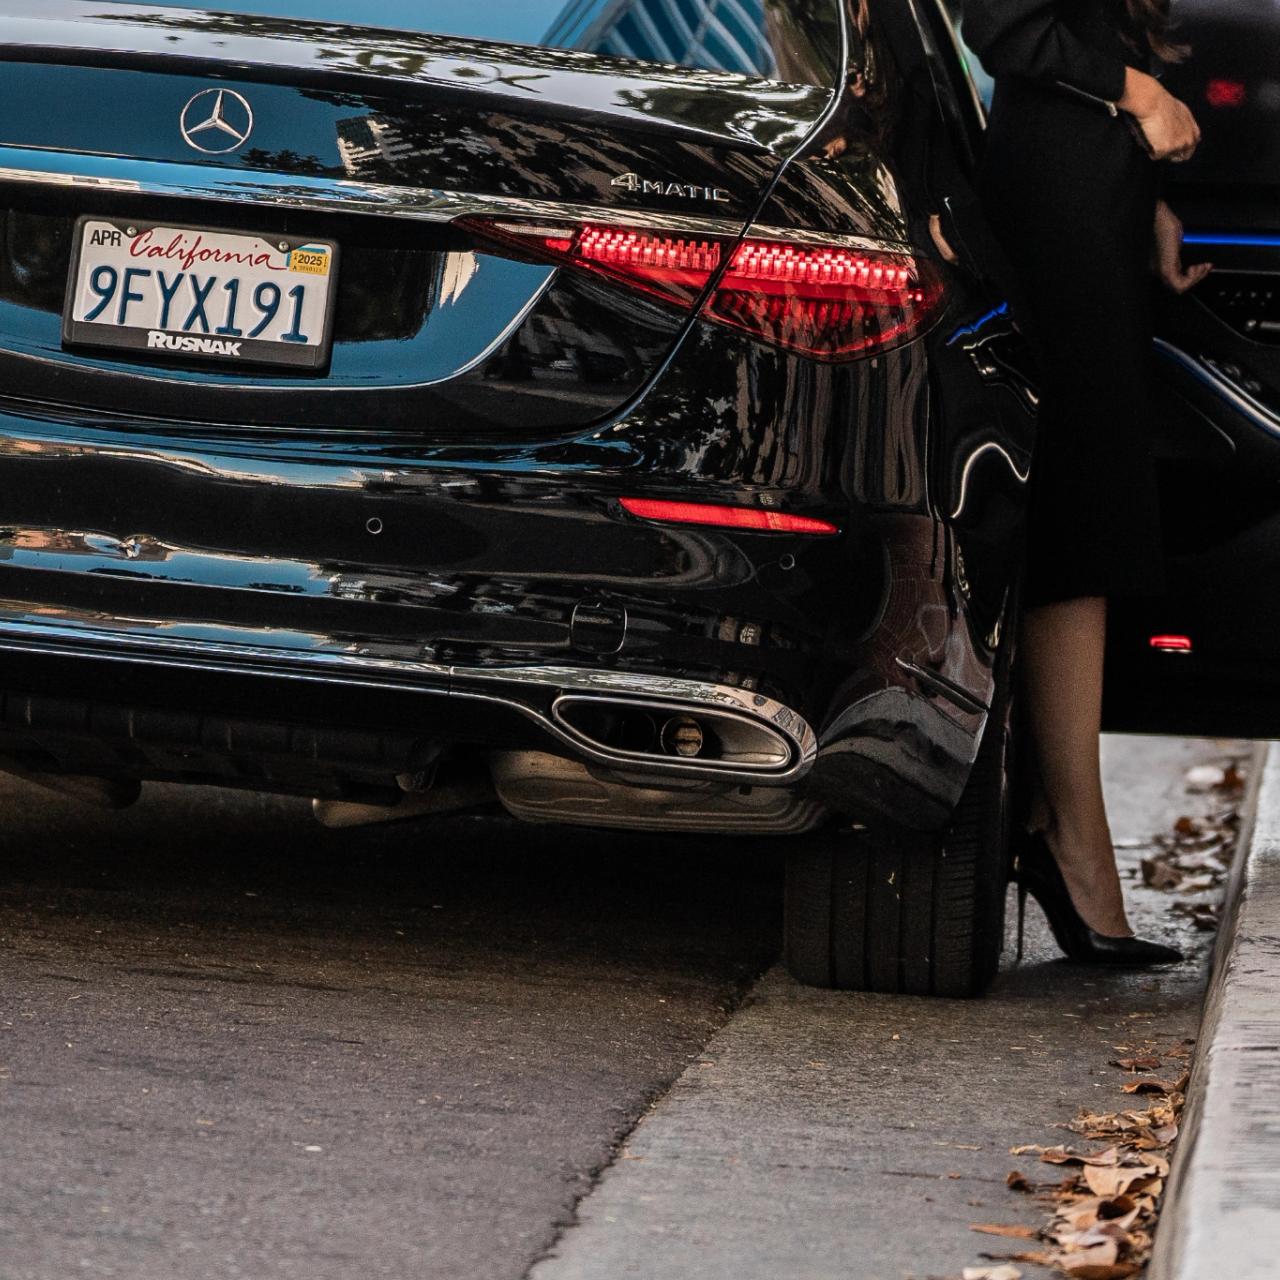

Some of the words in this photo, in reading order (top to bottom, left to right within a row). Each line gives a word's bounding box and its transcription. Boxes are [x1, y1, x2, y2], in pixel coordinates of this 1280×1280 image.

[610, 172, 730, 202] 4MATIC
[90, 228, 121, 247] APR
[129, 230, 287, 270] California
[298, 254, 322, 266] 2025
[84, 265, 308, 343] 9FYX191
[147, 330, 242, 357] RUSNAK
